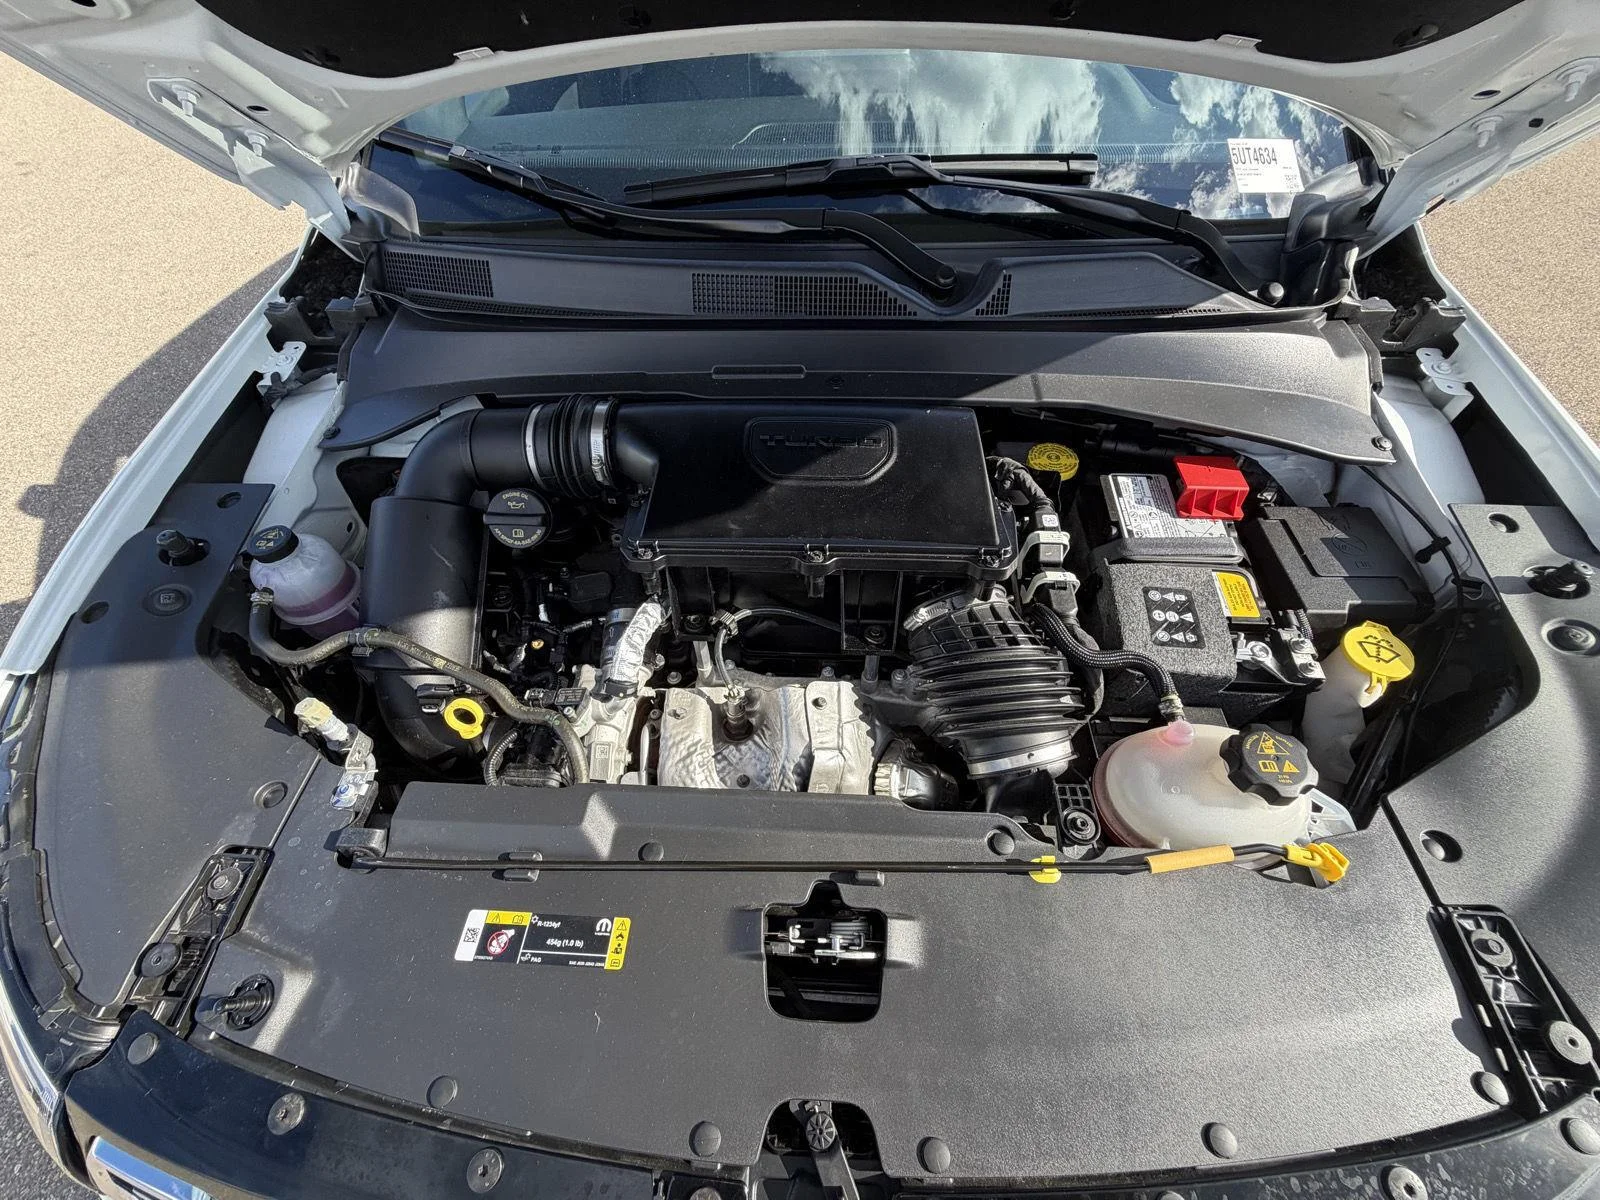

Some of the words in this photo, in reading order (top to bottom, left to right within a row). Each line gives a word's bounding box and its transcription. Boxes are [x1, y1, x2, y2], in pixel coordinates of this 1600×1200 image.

[1230, 147, 1278, 165] 5UT4634
[502, 491, 520, 500] ENGINE
[520, 493, 529, 501] OIL
[546, 938, 562, 947] 454g
